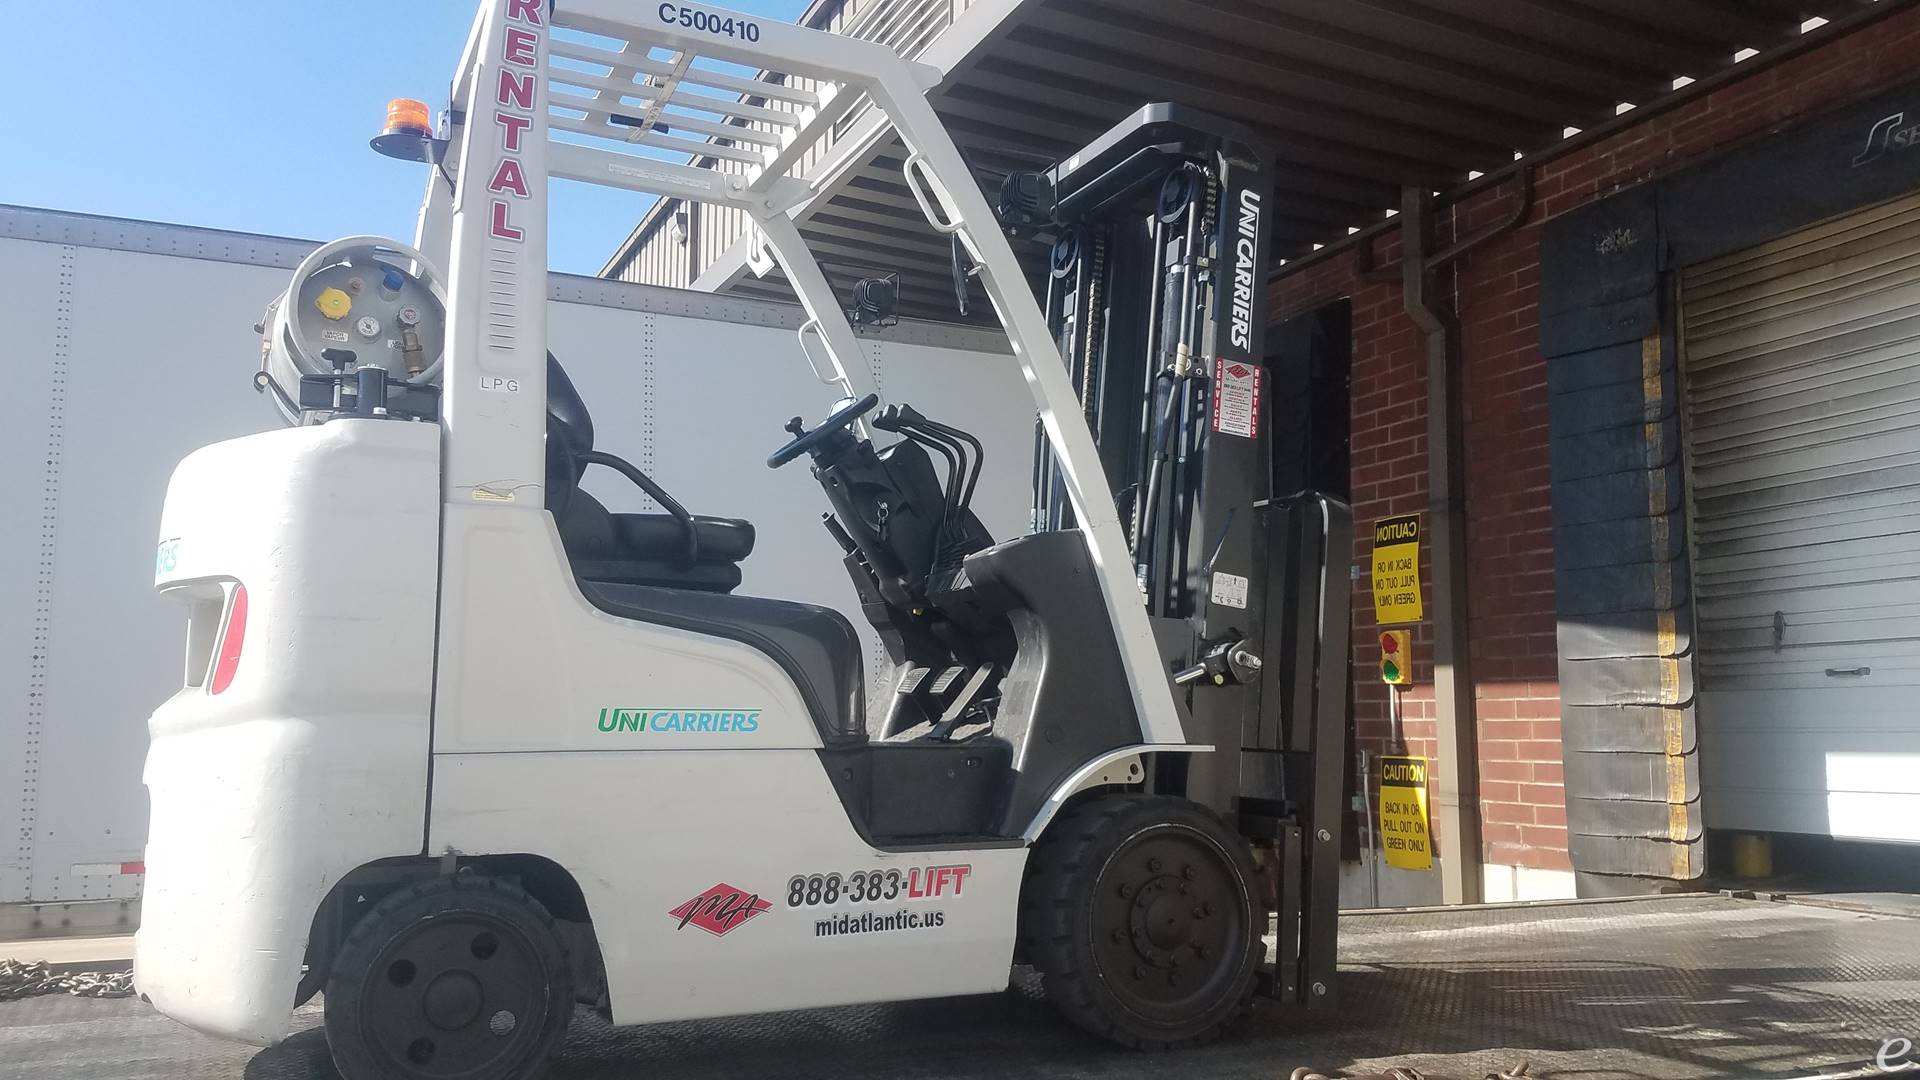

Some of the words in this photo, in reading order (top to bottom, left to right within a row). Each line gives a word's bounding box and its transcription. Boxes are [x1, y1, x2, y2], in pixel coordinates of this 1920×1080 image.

[658, 3, 760, 42] C500410
[489, 0, 542, 240] RENTAL
[1231, 189, 1260, 351] UNICARRIERS
[481, 377, 518, 392] LPG
[1213, 361, 1221, 428] SERVICE
[1251, 368, 1260, 435] RENTALS
[598, 707, 760, 732] UNICARRIERS
[1383, 764, 1424, 782] CAUTION
[1385, 802, 1400, 814] BACK
[1403, 804, 1409, 815] IN
[1411, 804, 1420, 816] OR
[1384, 819, 1398, 832] PULL
[1400, 821, 1412, 833] OUT
[1415, 822, 1424, 834] ON
[1386, 837, 1407, 851] GREEN
[1408, 839, 1424, 852] ONLY
[815, 909, 944, 937] midatlantic.us
